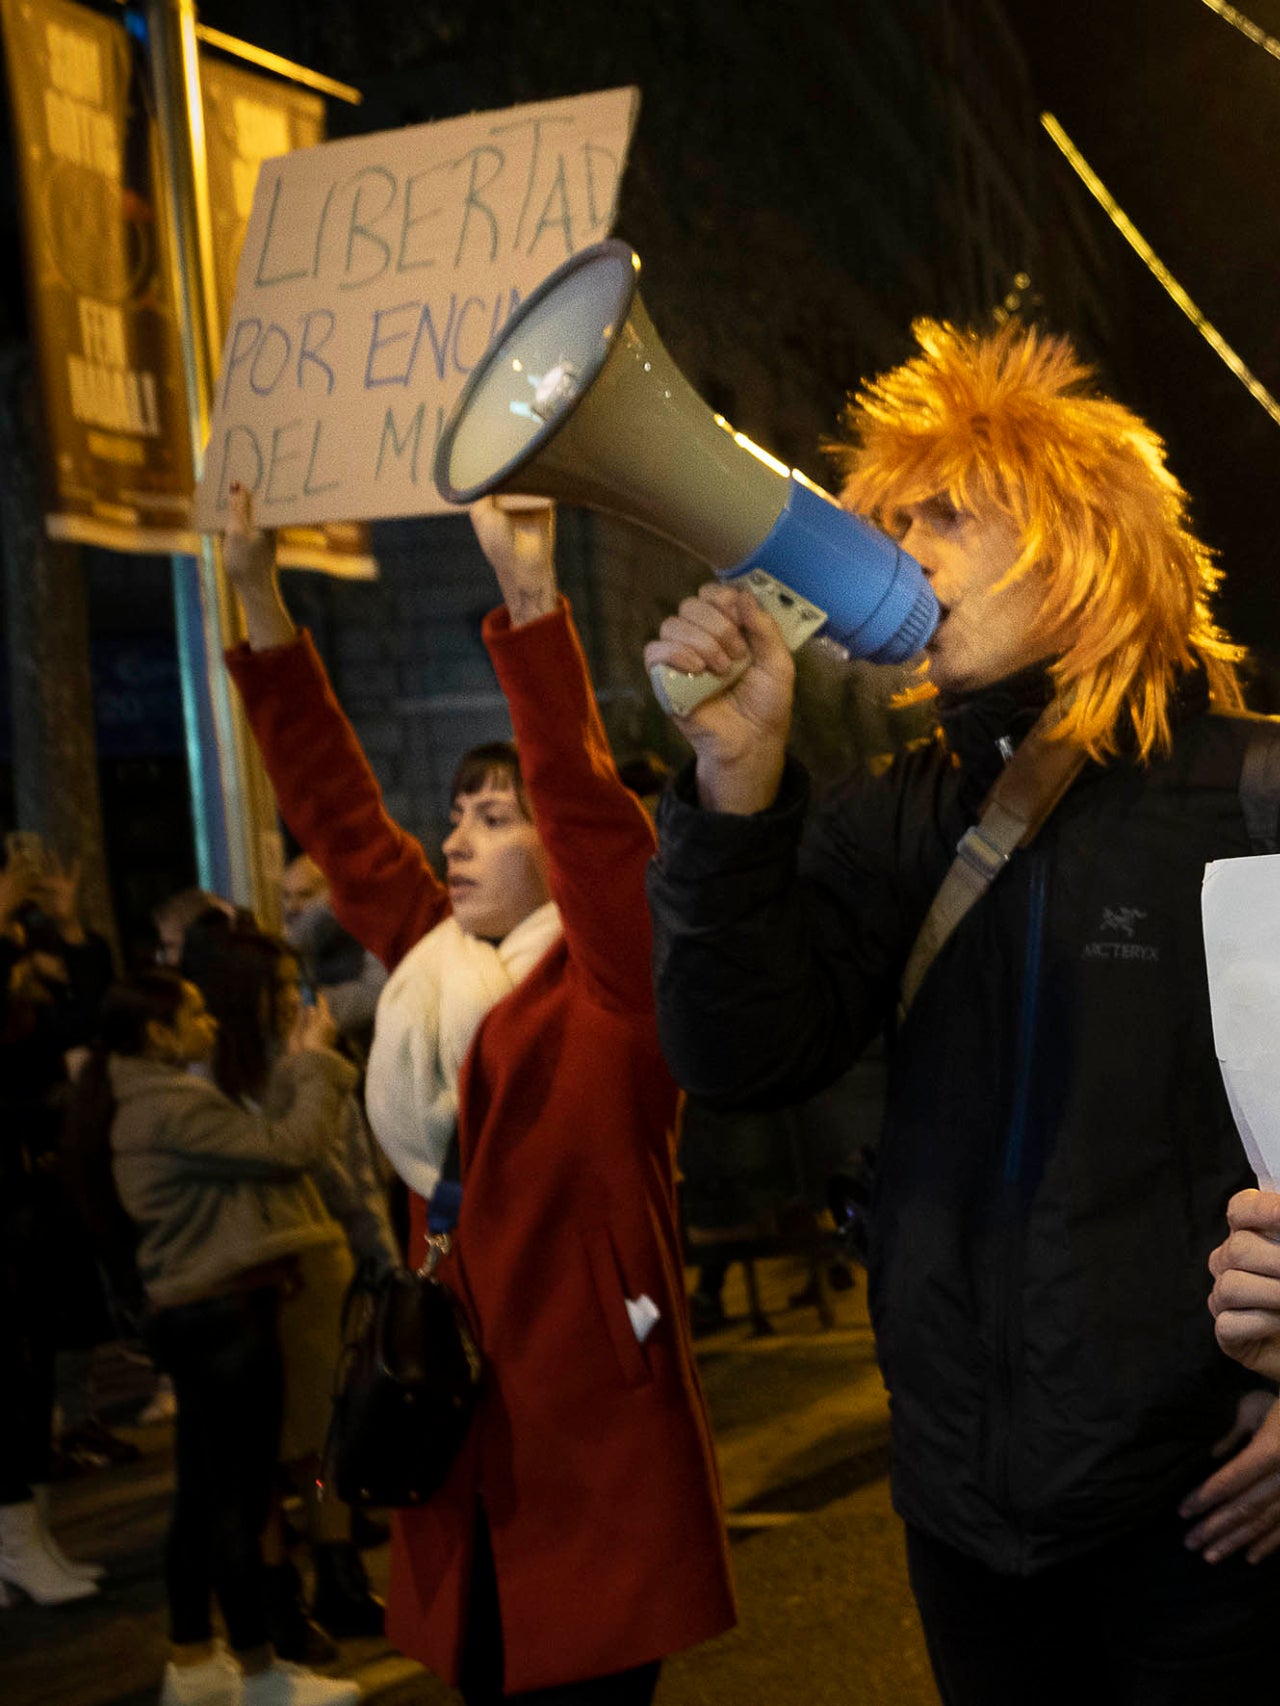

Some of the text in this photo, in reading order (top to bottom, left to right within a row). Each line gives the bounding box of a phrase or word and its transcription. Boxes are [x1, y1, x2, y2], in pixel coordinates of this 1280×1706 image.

[254, 115, 622, 290] LIBERTAD
[222, 308, 337, 412] POR
[363, 287, 522, 390] ENCI
[216, 419, 340, 511] DEL
[374, 402, 444, 486] MI
